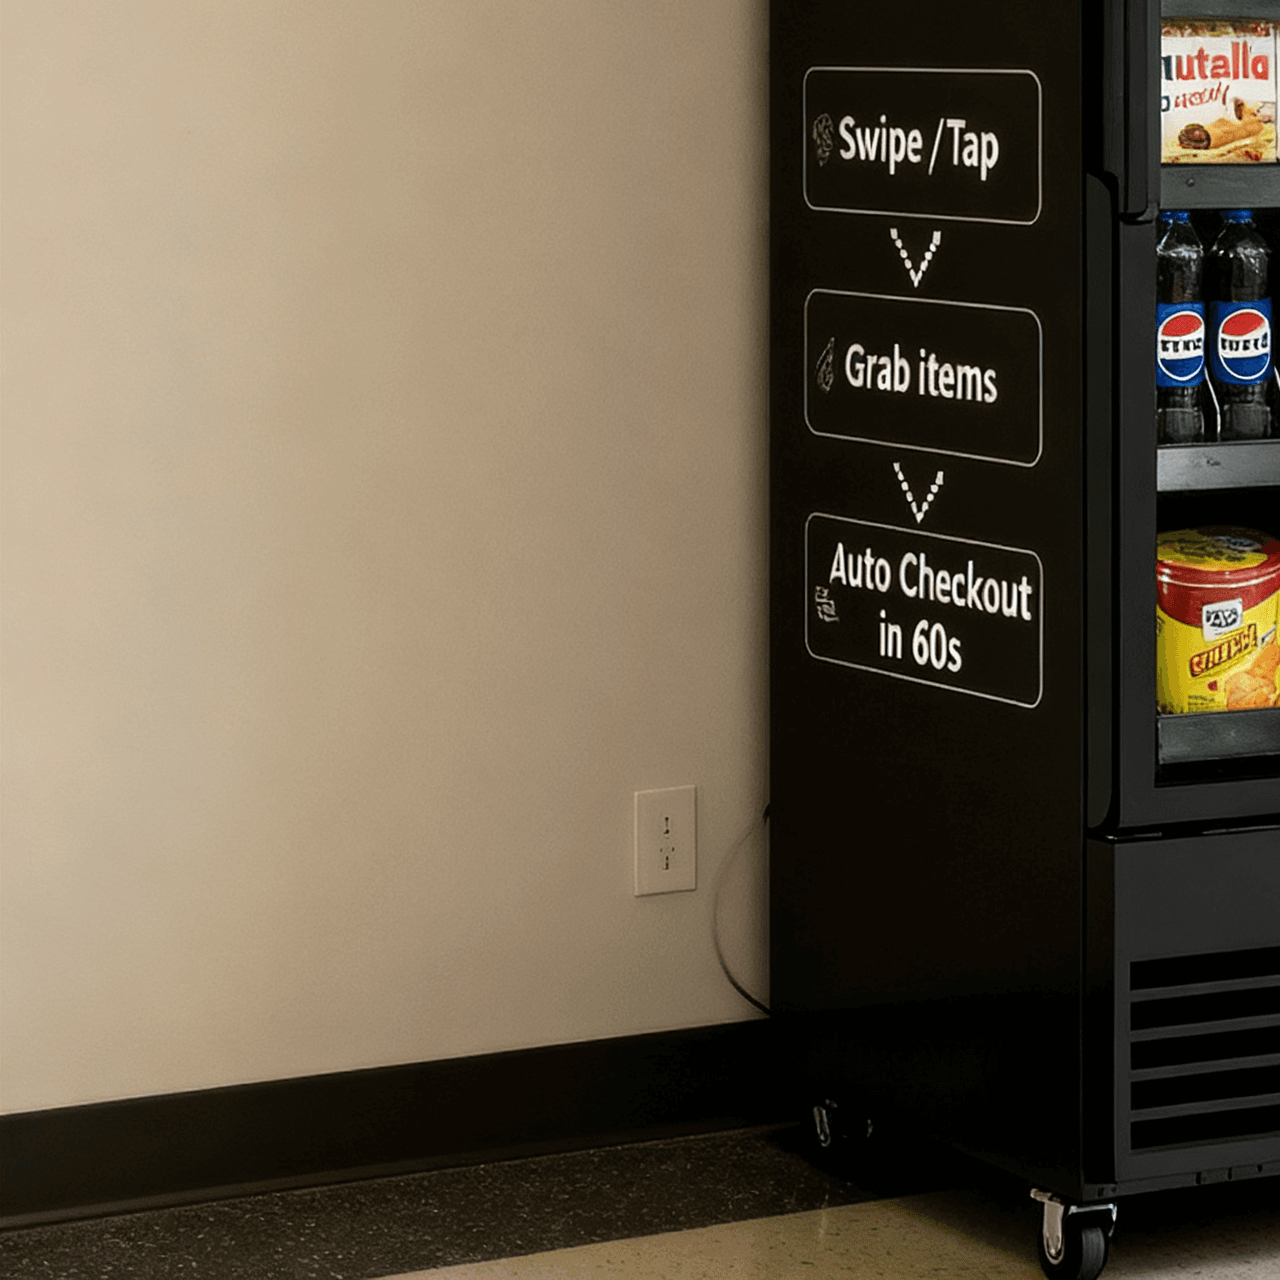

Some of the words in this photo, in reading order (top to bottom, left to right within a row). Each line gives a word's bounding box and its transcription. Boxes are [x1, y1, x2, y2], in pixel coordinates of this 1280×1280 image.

[838, 114, 924, 176] Swipe
[844, 343, 911, 393] Grab
[918, 348, 998, 404] items
[829, 542, 892, 593] Auto
[898, 551, 1033, 621] Checkout
[879, 608, 903, 660] in
[911, 619, 963, 673] 60s
